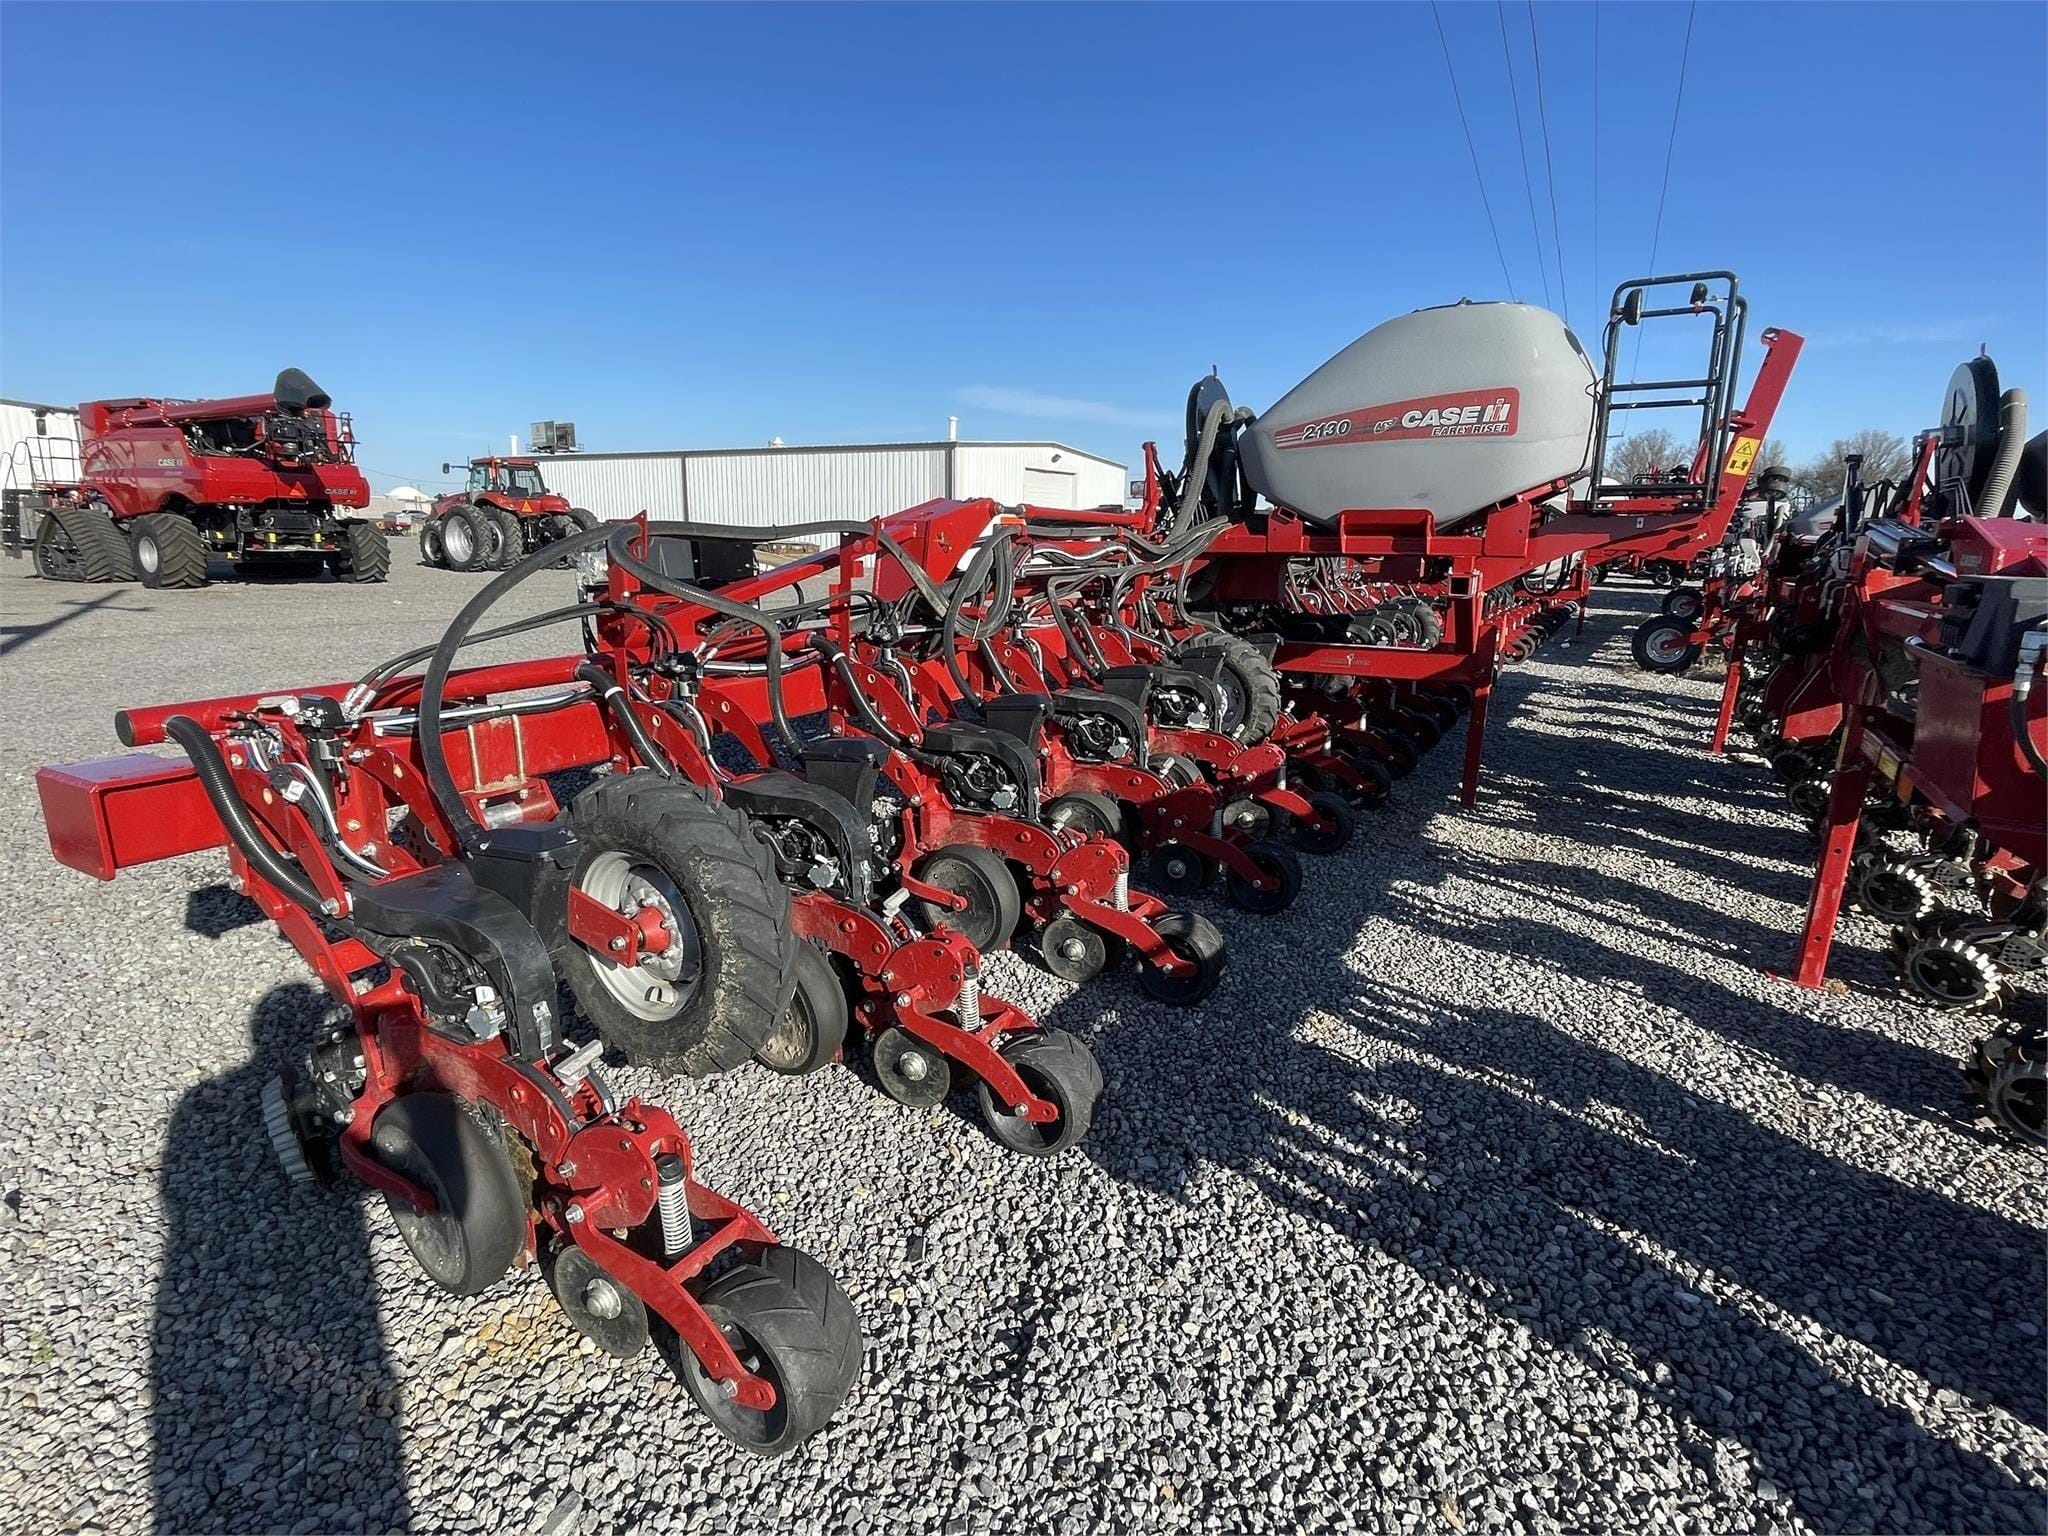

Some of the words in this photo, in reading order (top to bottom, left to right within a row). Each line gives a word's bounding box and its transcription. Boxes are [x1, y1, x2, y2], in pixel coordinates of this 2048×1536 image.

[1401, 406, 1481, 429] CASE
[1302, 419, 1351, 441] 2130
[1431, 424, 1471, 437] EARLY
[1471, 422, 1509, 434] RISER
